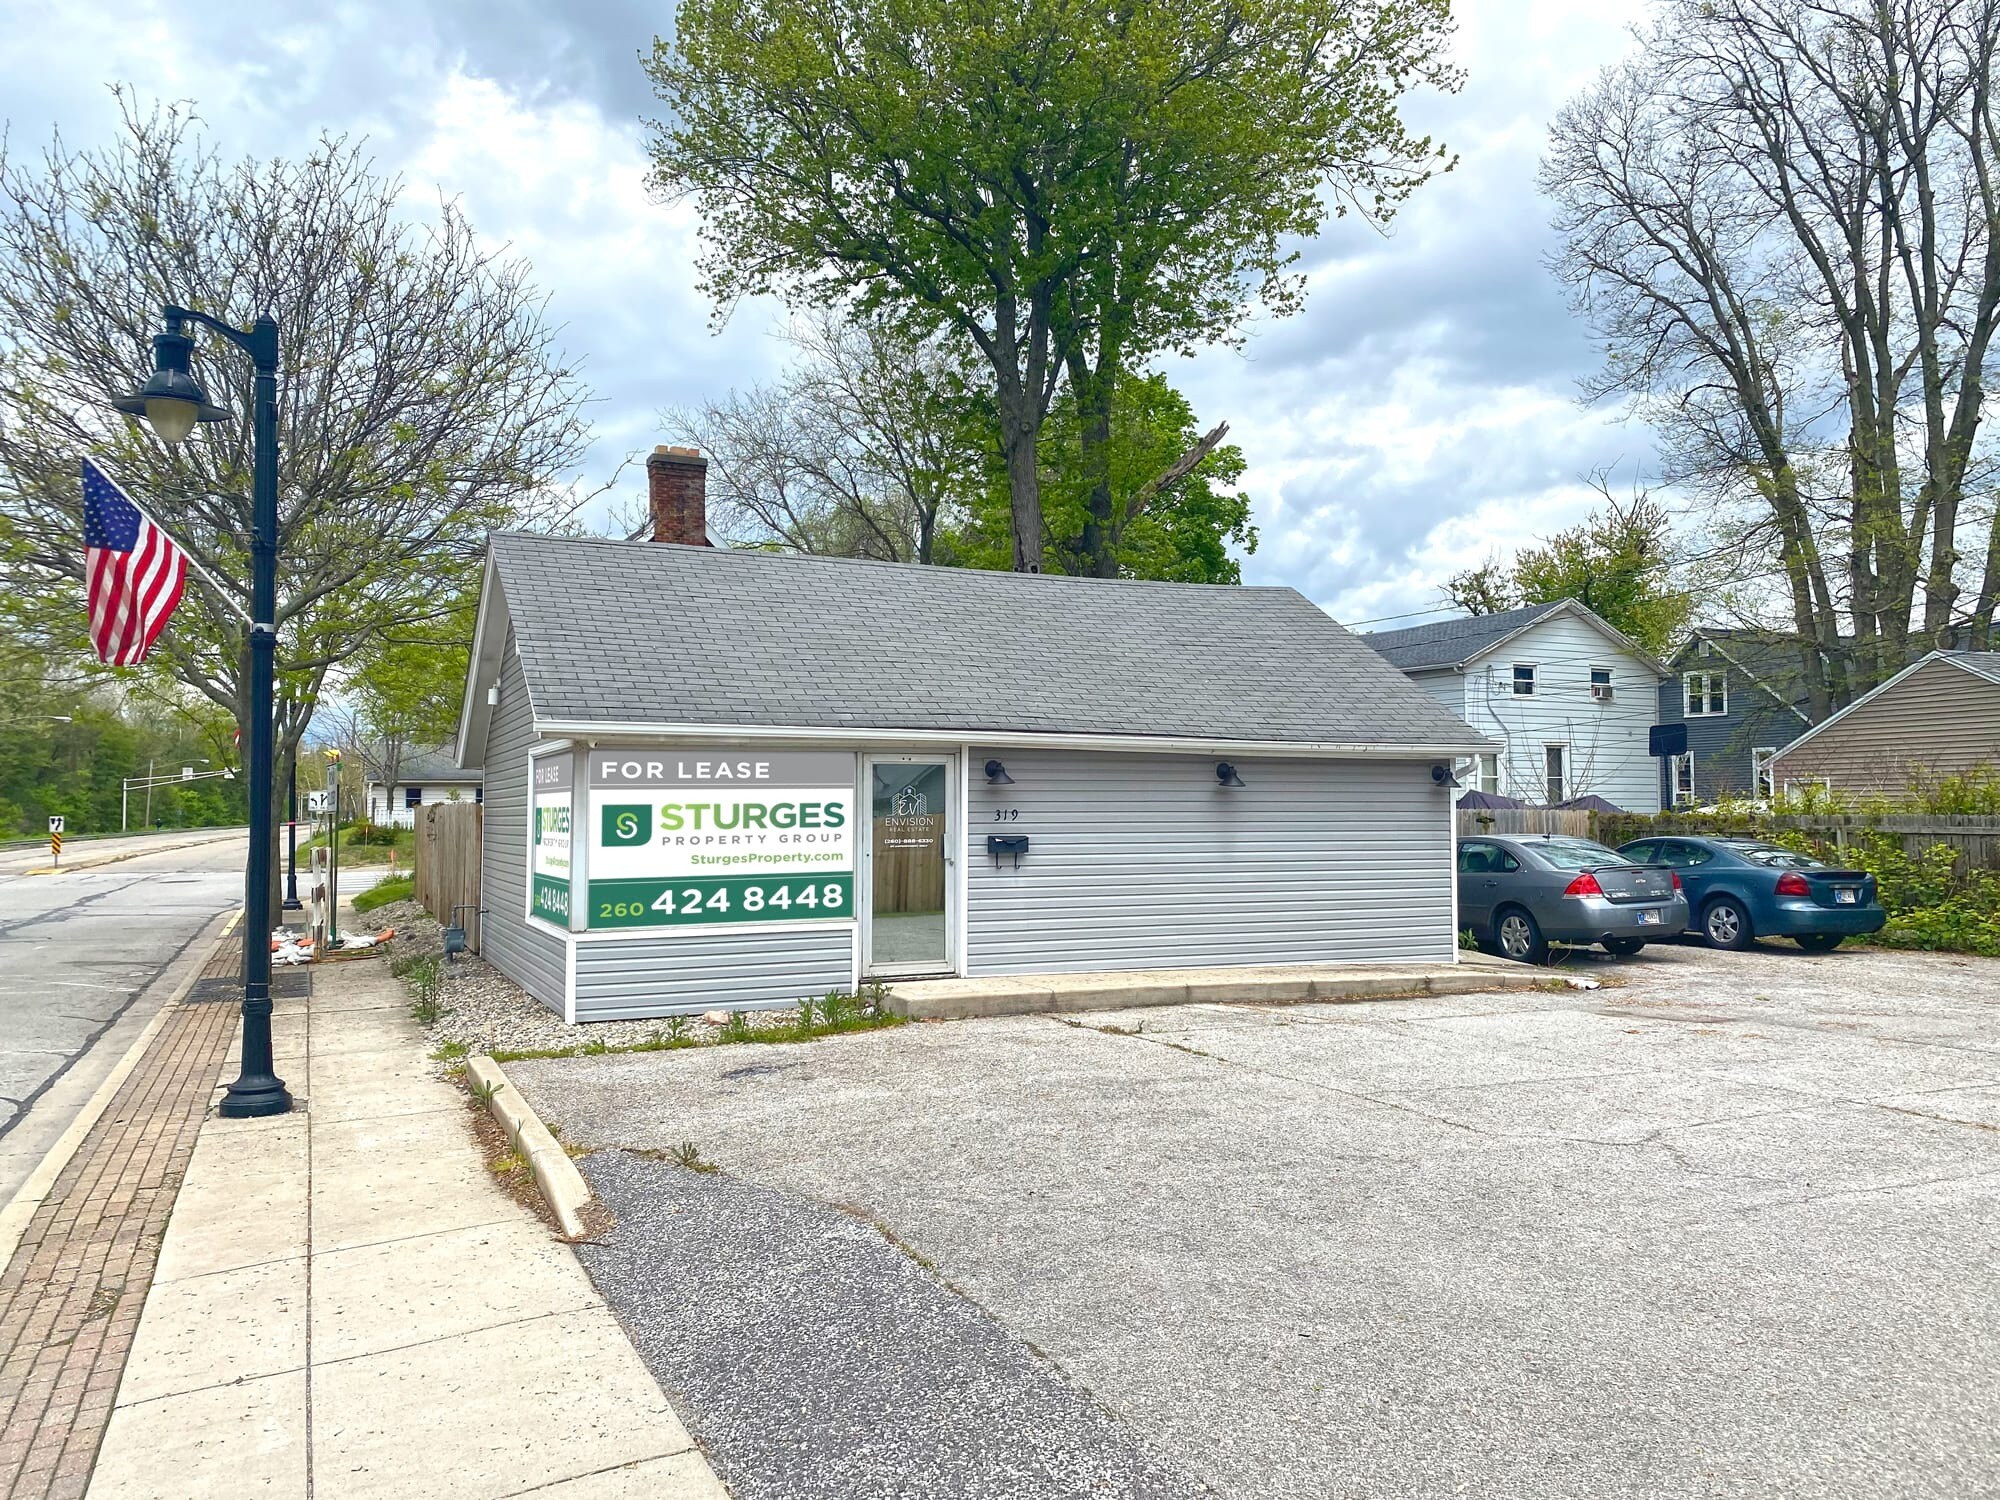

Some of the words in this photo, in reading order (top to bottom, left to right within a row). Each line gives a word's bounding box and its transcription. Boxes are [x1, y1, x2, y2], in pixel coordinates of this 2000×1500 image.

[535, 768, 545, 785] FOR
[545, 765, 559, 784] LEASE
[601, 761, 665, 779] FOR
[678, 761, 770, 779] LEASE
[542, 806, 570, 834] STURGES
[660, 802, 846, 831] STURGES
[885, 817, 934, 827] ENVISION
[994, 810, 1019, 822] 319
[661, 834, 767, 846] PROPERTY
[778, 833, 842, 844] GROUP
[690, 852, 844, 866] SturgesProperty.com
[541, 886, 552, 911] 424
[552, 888, 569, 917] 8448
[599, 902, 644, 918] 260
[650, 887, 731, 915] 424
[743, 883, 843, 912] 8448
